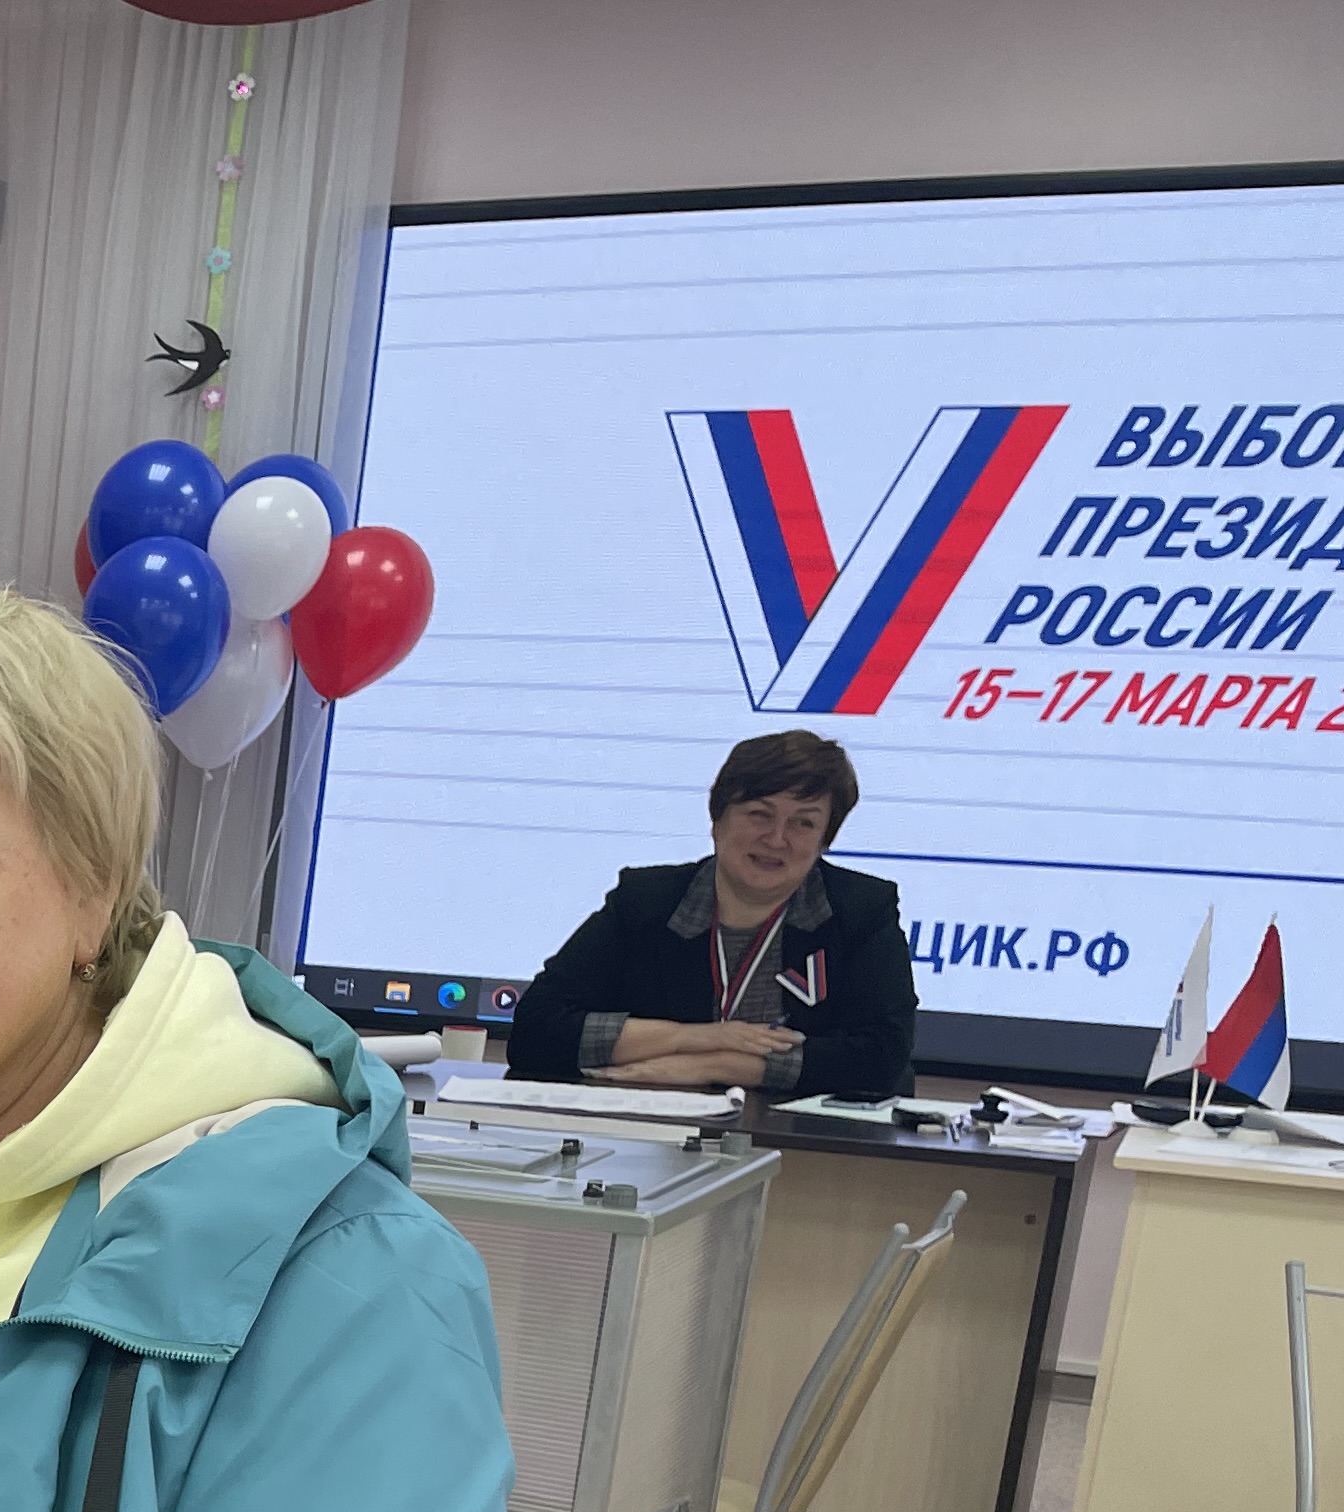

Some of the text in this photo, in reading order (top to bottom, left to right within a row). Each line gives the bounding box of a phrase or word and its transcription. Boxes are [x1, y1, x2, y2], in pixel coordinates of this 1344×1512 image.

[1096, 404, 1344, 468] ВЫБО
[1040, 496, 1344, 571] ПРЕЗИД
[984, 585, 1334, 650] РОССИИ
[1103, 671, 1317, 731] МАРТА
[909, 921, 1129, 977] ЦИК.РФ
